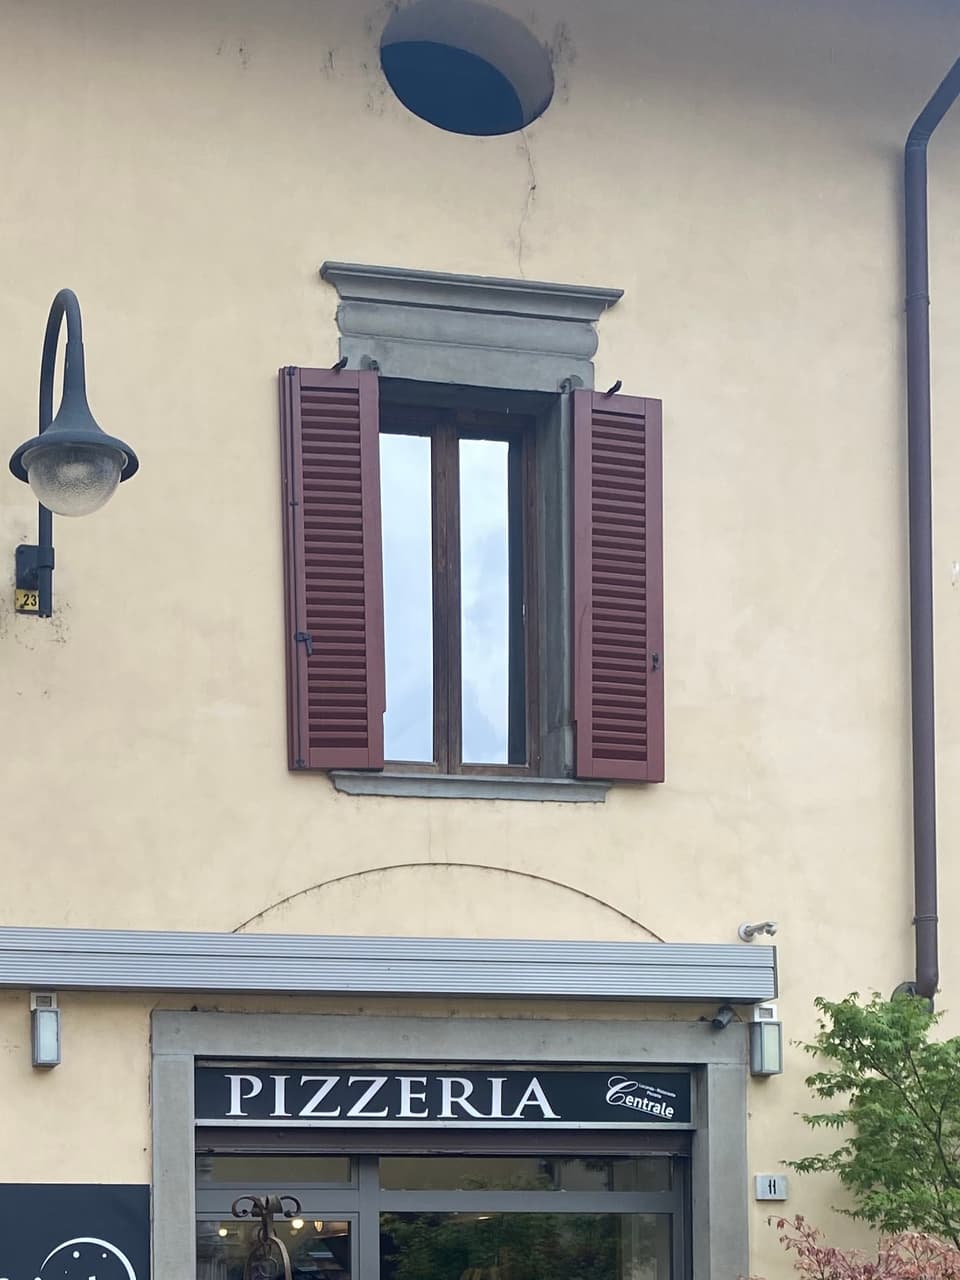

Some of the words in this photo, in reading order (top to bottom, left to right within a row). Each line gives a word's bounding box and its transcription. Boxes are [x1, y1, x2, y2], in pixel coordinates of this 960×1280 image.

[23, 594, 37, 607] 23
[224, 1074, 561, 1120] PIZZERIA
[606, 1075, 674, 1119] Centrale
[768, 1178, 777, 1195] 11
